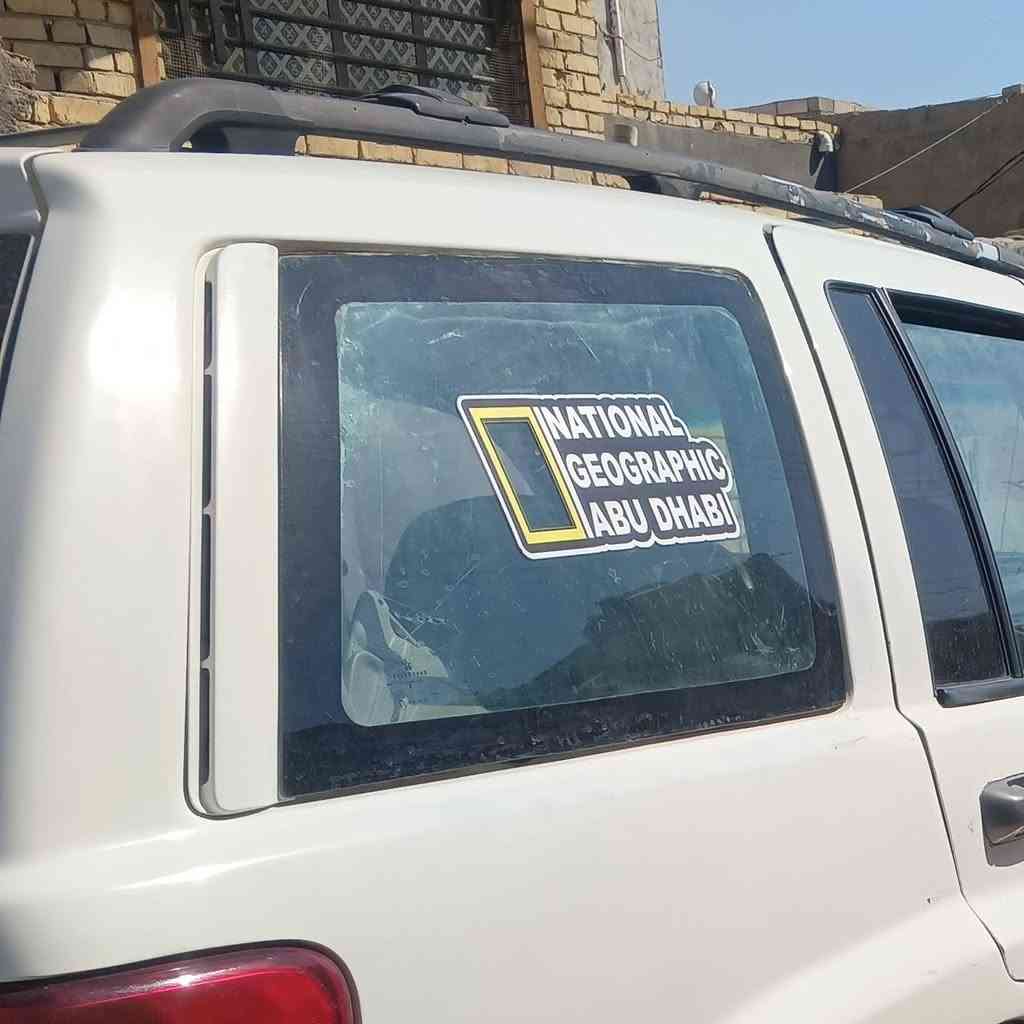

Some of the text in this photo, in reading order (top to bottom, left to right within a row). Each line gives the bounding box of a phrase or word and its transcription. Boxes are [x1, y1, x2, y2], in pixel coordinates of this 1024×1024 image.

[541, 404, 685, 440] NATIONAL
[564, 448, 726, 489] GEOGRAPHIC
[589, 492, 733, 538] ABU DHABI
